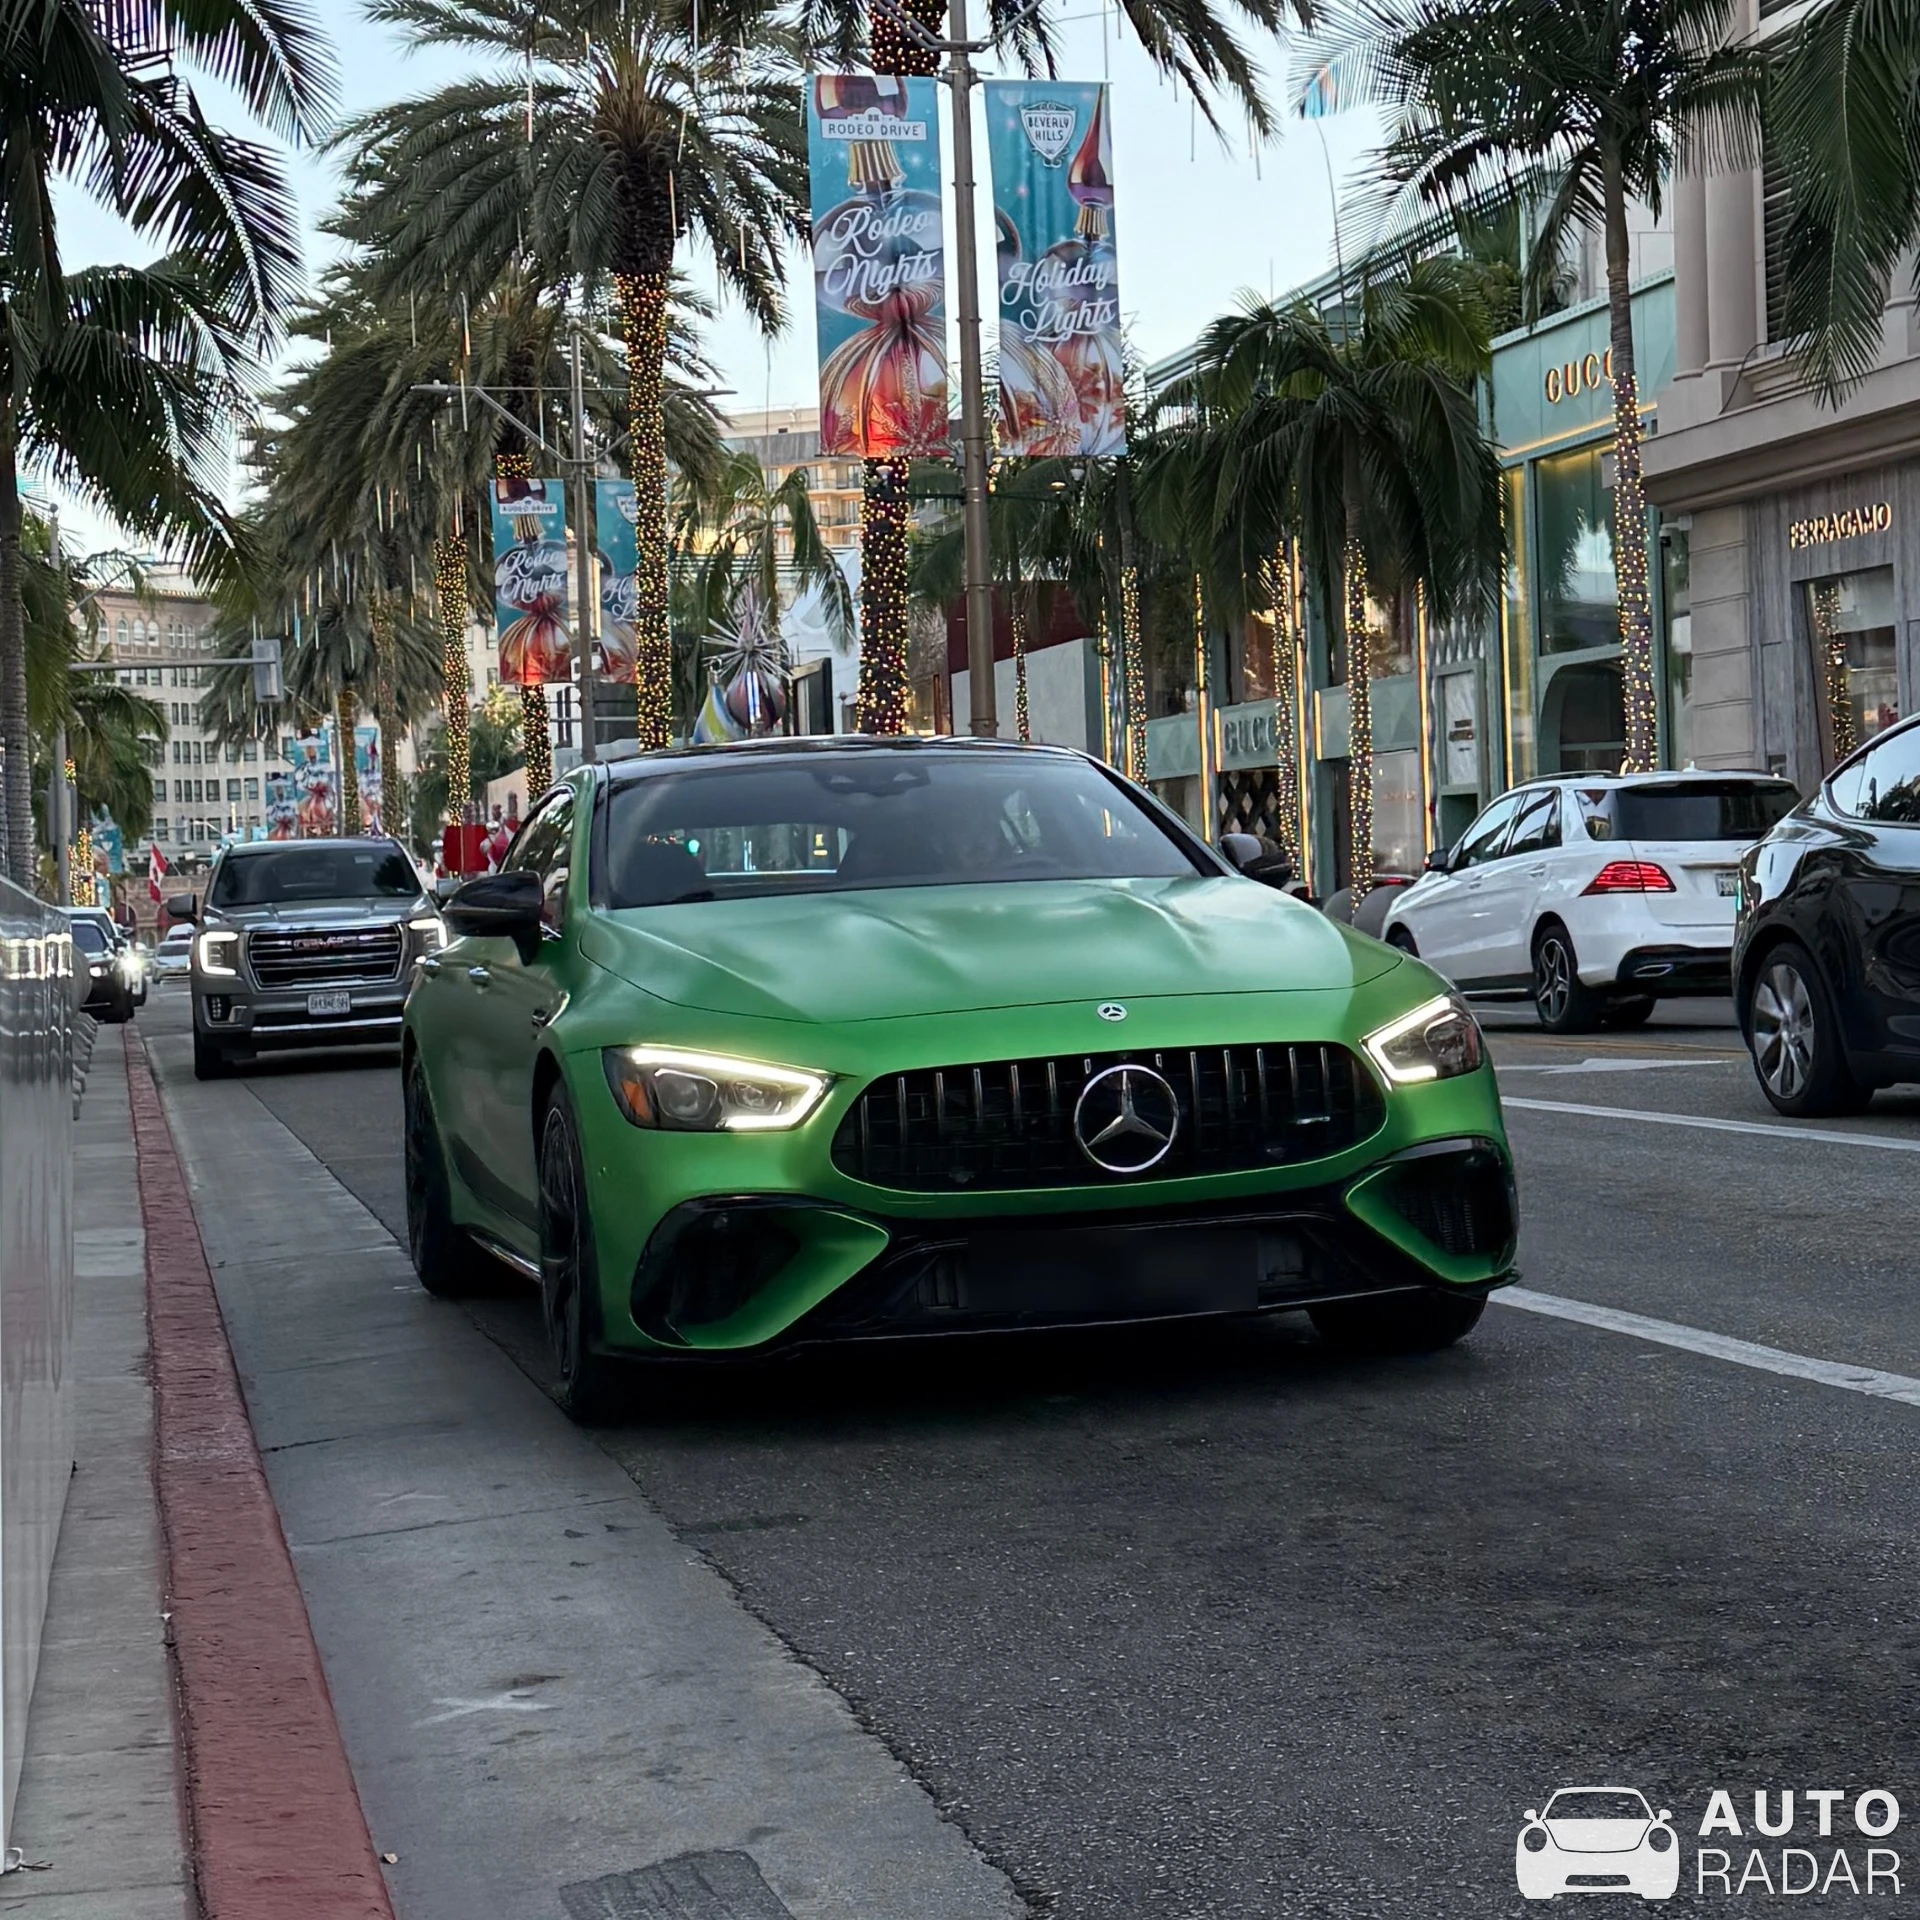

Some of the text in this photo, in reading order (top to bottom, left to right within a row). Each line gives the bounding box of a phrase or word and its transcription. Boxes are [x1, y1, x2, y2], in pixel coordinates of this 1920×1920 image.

[828, 123, 920, 137] RODEO DRIVE
[1028, 116, 1070, 129] BEVERLY
[1035, 130, 1064, 142] HILLS
[826, 206, 929, 257] Rodeo
[823, 251, 940, 305] Nights
[1001, 257, 1111, 307] Holiday
[1020, 297, 1118, 343] Lights
[1545, 345, 1615, 404] GUCC
[1789, 501, 1892, 549] FERRAGAMO
[504, 549, 560, 578] Rodeo
[500, 572, 564, 603] Nights
[1224, 714, 1278, 753] GUCC
